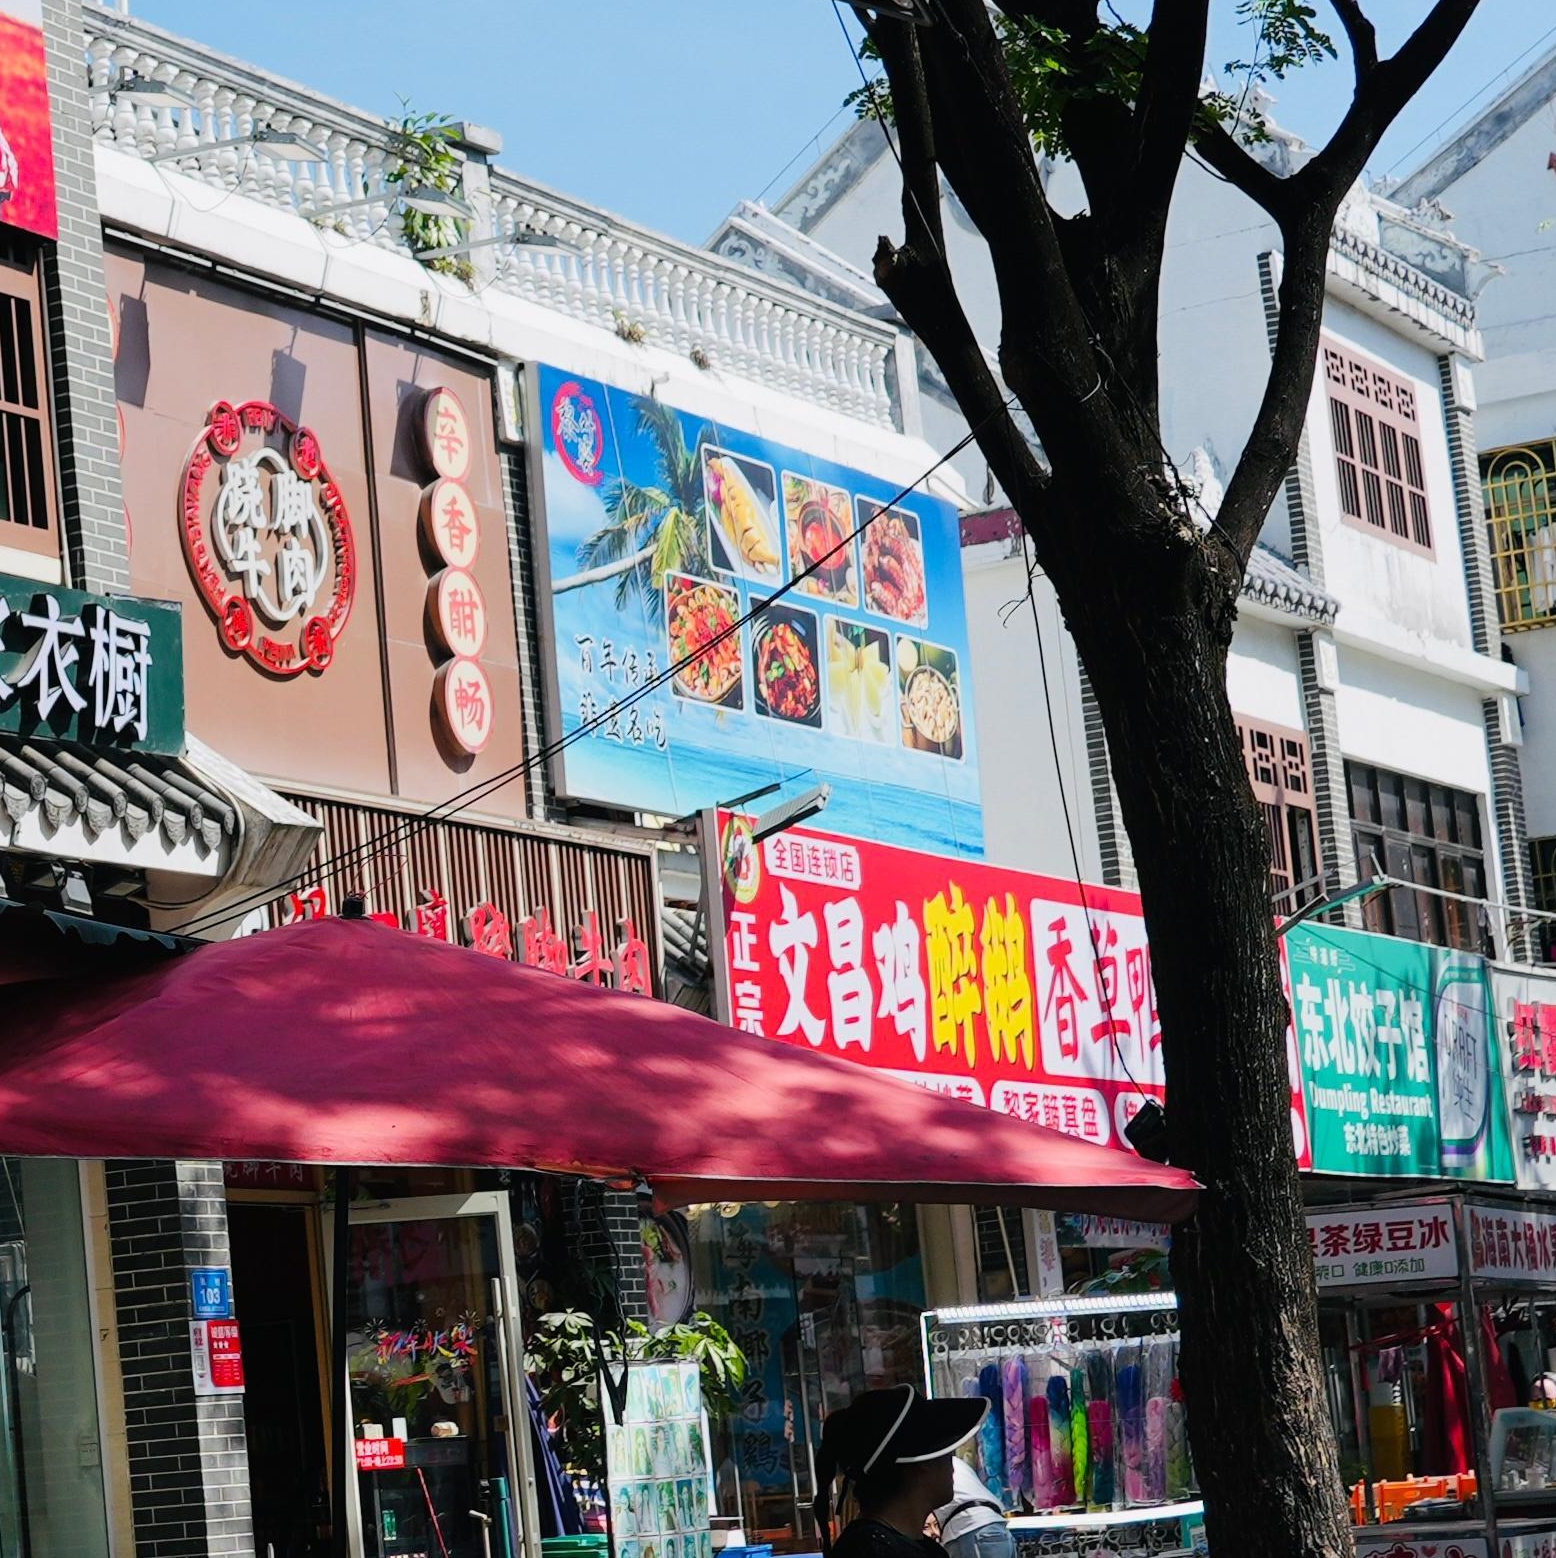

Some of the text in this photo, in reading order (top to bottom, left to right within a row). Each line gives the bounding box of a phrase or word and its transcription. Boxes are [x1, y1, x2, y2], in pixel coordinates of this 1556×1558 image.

[232, 526, 316, 608] 牛肉
[436, 409, 488, 731] 辛香酣畅
[771, 838, 856, 882] 全国连锁店
[729, 910, 765, 1037] 正宗
[1296, 973, 1430, 1083] 东北饺子馆
[1308, 1081, 1369, 1121] Dumpling
[1370, 1088, 1434, 1119] Restaurant
[200, 1288, 222, 1305] 103
